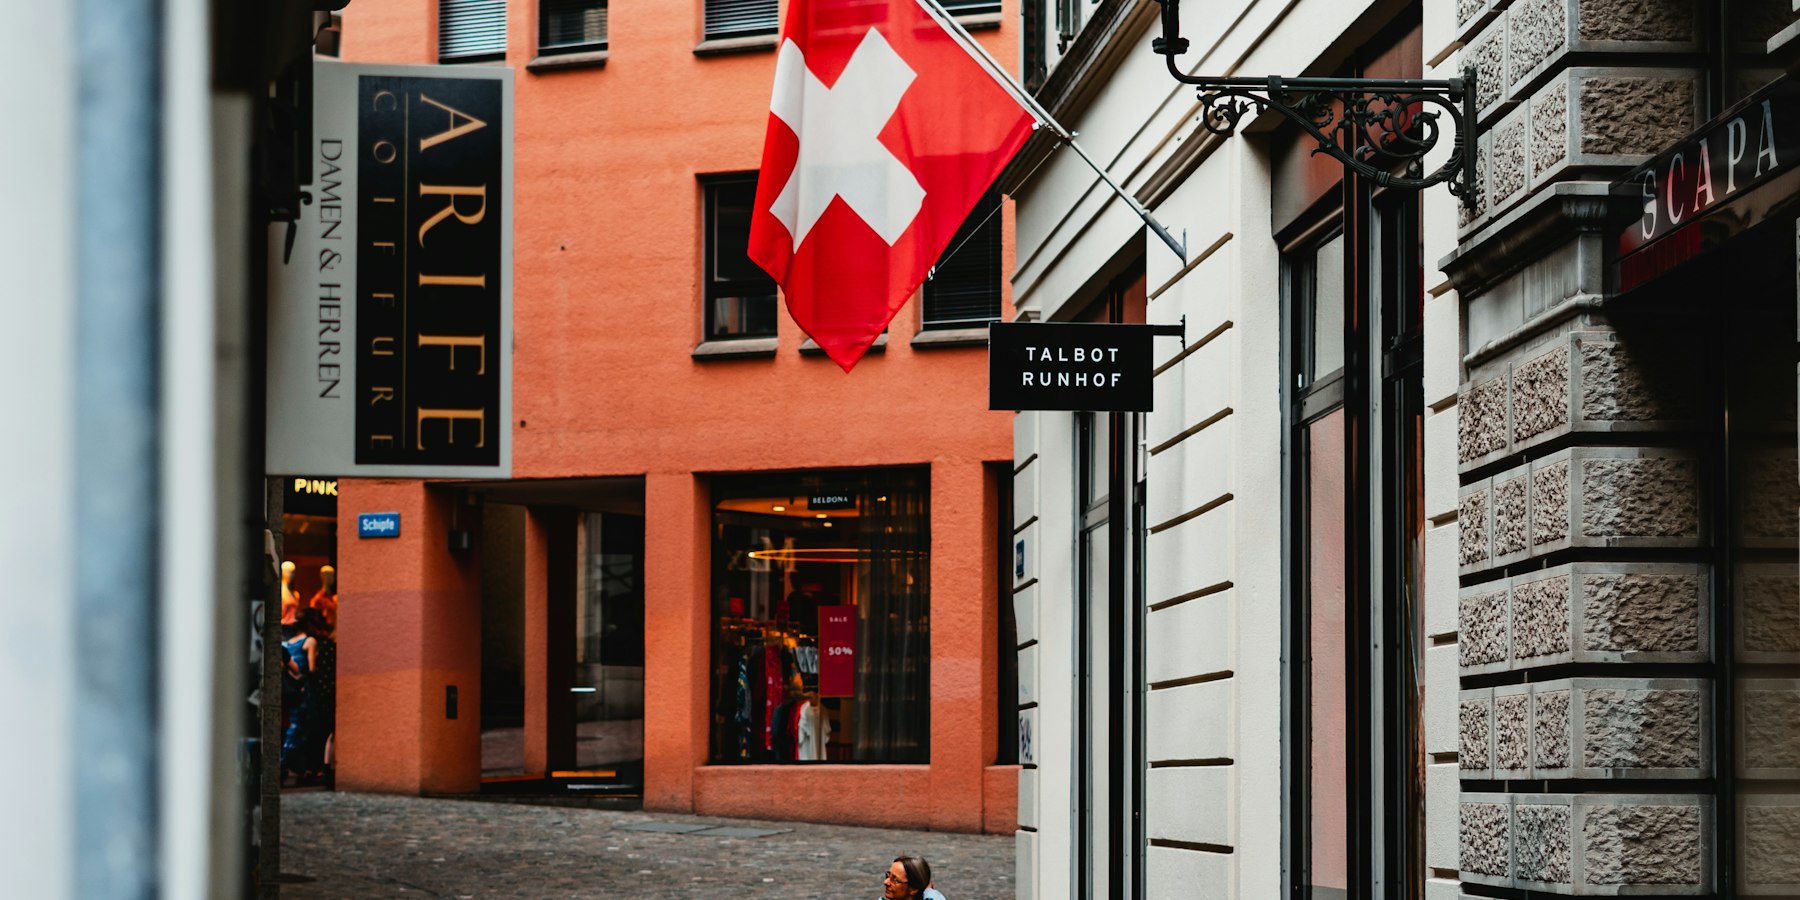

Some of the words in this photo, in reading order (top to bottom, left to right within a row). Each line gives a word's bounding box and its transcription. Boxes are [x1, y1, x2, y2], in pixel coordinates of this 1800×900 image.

[319, 138, 343, 240] DAMEN
[1641, 98, 1779, 241] SCAPA
[318, 248, 342, 272] &
[370, 90, 397, 450] COIFFURE
[417, 93, 488, 451] ARIFE
[318, 283, 342, 400] HERREN
[1026, 347, 1118, 363] TALBOT
[1022, 372, 1121, 388] RUNHOF
[362, 517, 395, 532] Schipfe
[812, 495, 849, 504] BELDONA
